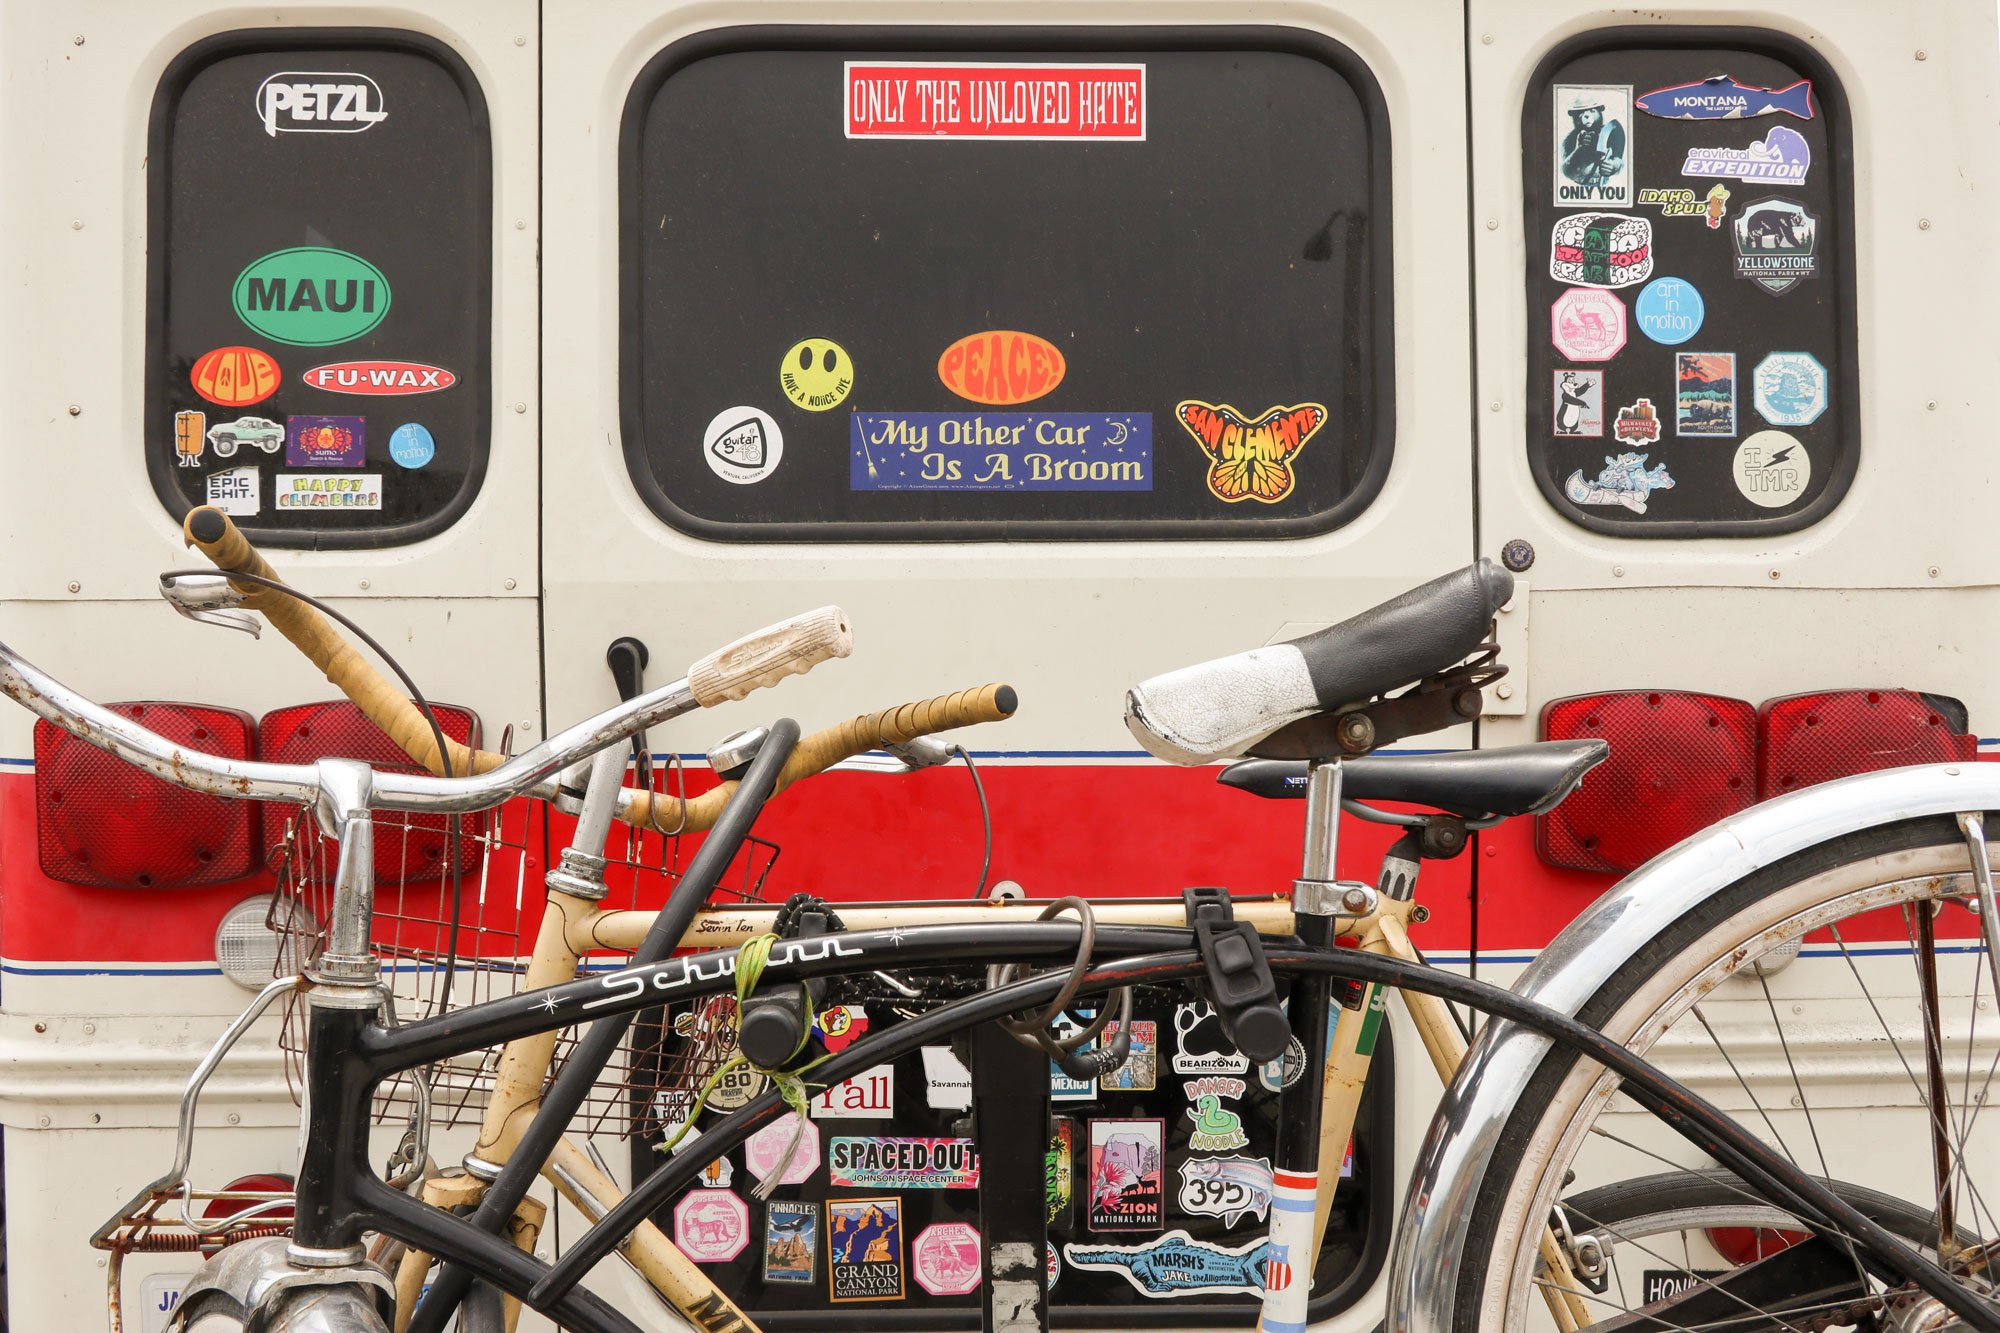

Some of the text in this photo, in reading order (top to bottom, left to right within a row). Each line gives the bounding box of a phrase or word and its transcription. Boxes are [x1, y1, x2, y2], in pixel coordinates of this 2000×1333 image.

[853, 80, 1137, 131] ONLY THE UNLOVED HATE
[1674, 96, 1747, 107] MONTANA
[265, 83, 388, 137] PETZL
[1690, 148, 1750, 160] eravirtual
[1685, 160, 1804, 178] EXPEDITION
[1560, 186, 1625, 200] ONLY YOU
[1641, 190, 1693, 203] IDAHO
[1664, 203, 1707, 215] SPUD
[1737, 257, 1814, 268] YELLOWSTONE
[247, 277, 375, 313] MAUI
[1656, 283, 1683, 297] art
[1665, 299, 1680, 312] in
[1644, 313, 1692, 329] motion
[944, 334, 1060, 401] PEACE!
[783, 373, 799, 395] HAVE
[797, 392, 805, 402] A
[836, 377, 850, 395] DYE
[870, 416, 1090, 453] My Other Car
[1186, 405, 1317, 461] SAN CLEMENTE
[723, 433, 758, 454] guitar
[921, 453, 1144, 482] Is A Broom
[210, 478, 249, 488] EPIC
[293, 478, 363, 492] HAPPY
[1745, 468, 1799, 492] TMR
[210, 489, 255, 499] SHIT.
[279, 492, 379, 507] CLIMBERS
[736, 919, 753, 932] Ten
[1180, 1058, 1241, 1068] BEARIZONA
[931, 1080, 972, 1088] Savannah
[1186, 1078, 1244, 1099] DANGER
[1190, 1129, 1247, 1149] NOODLE
[834, 1143, 976, 1171] SPACED OUT
[928, 1175, 964, 1183] CENTER
[1189, 1179, 1244, 1207] 395
[769, 1202, 816, 1215] PINNACLES
[1120, 1203, 1158, 1214] ZION
[1094, 1215, 1157, 1223] NATIONAL PARK
[930, 1225, 966, 1236] ARCHES
[1151, 1253, 1205, 1270] MARSH'S
[835, 1264, 899, 1279] GRAND
[1162, 1270, 1191, 1282] JAKE
[1192, 1274, 1204, 1282] the
[836, 1276, 899, 1290] CANYON
[836, 1287, 899, 1296] NATIONAL PARK
